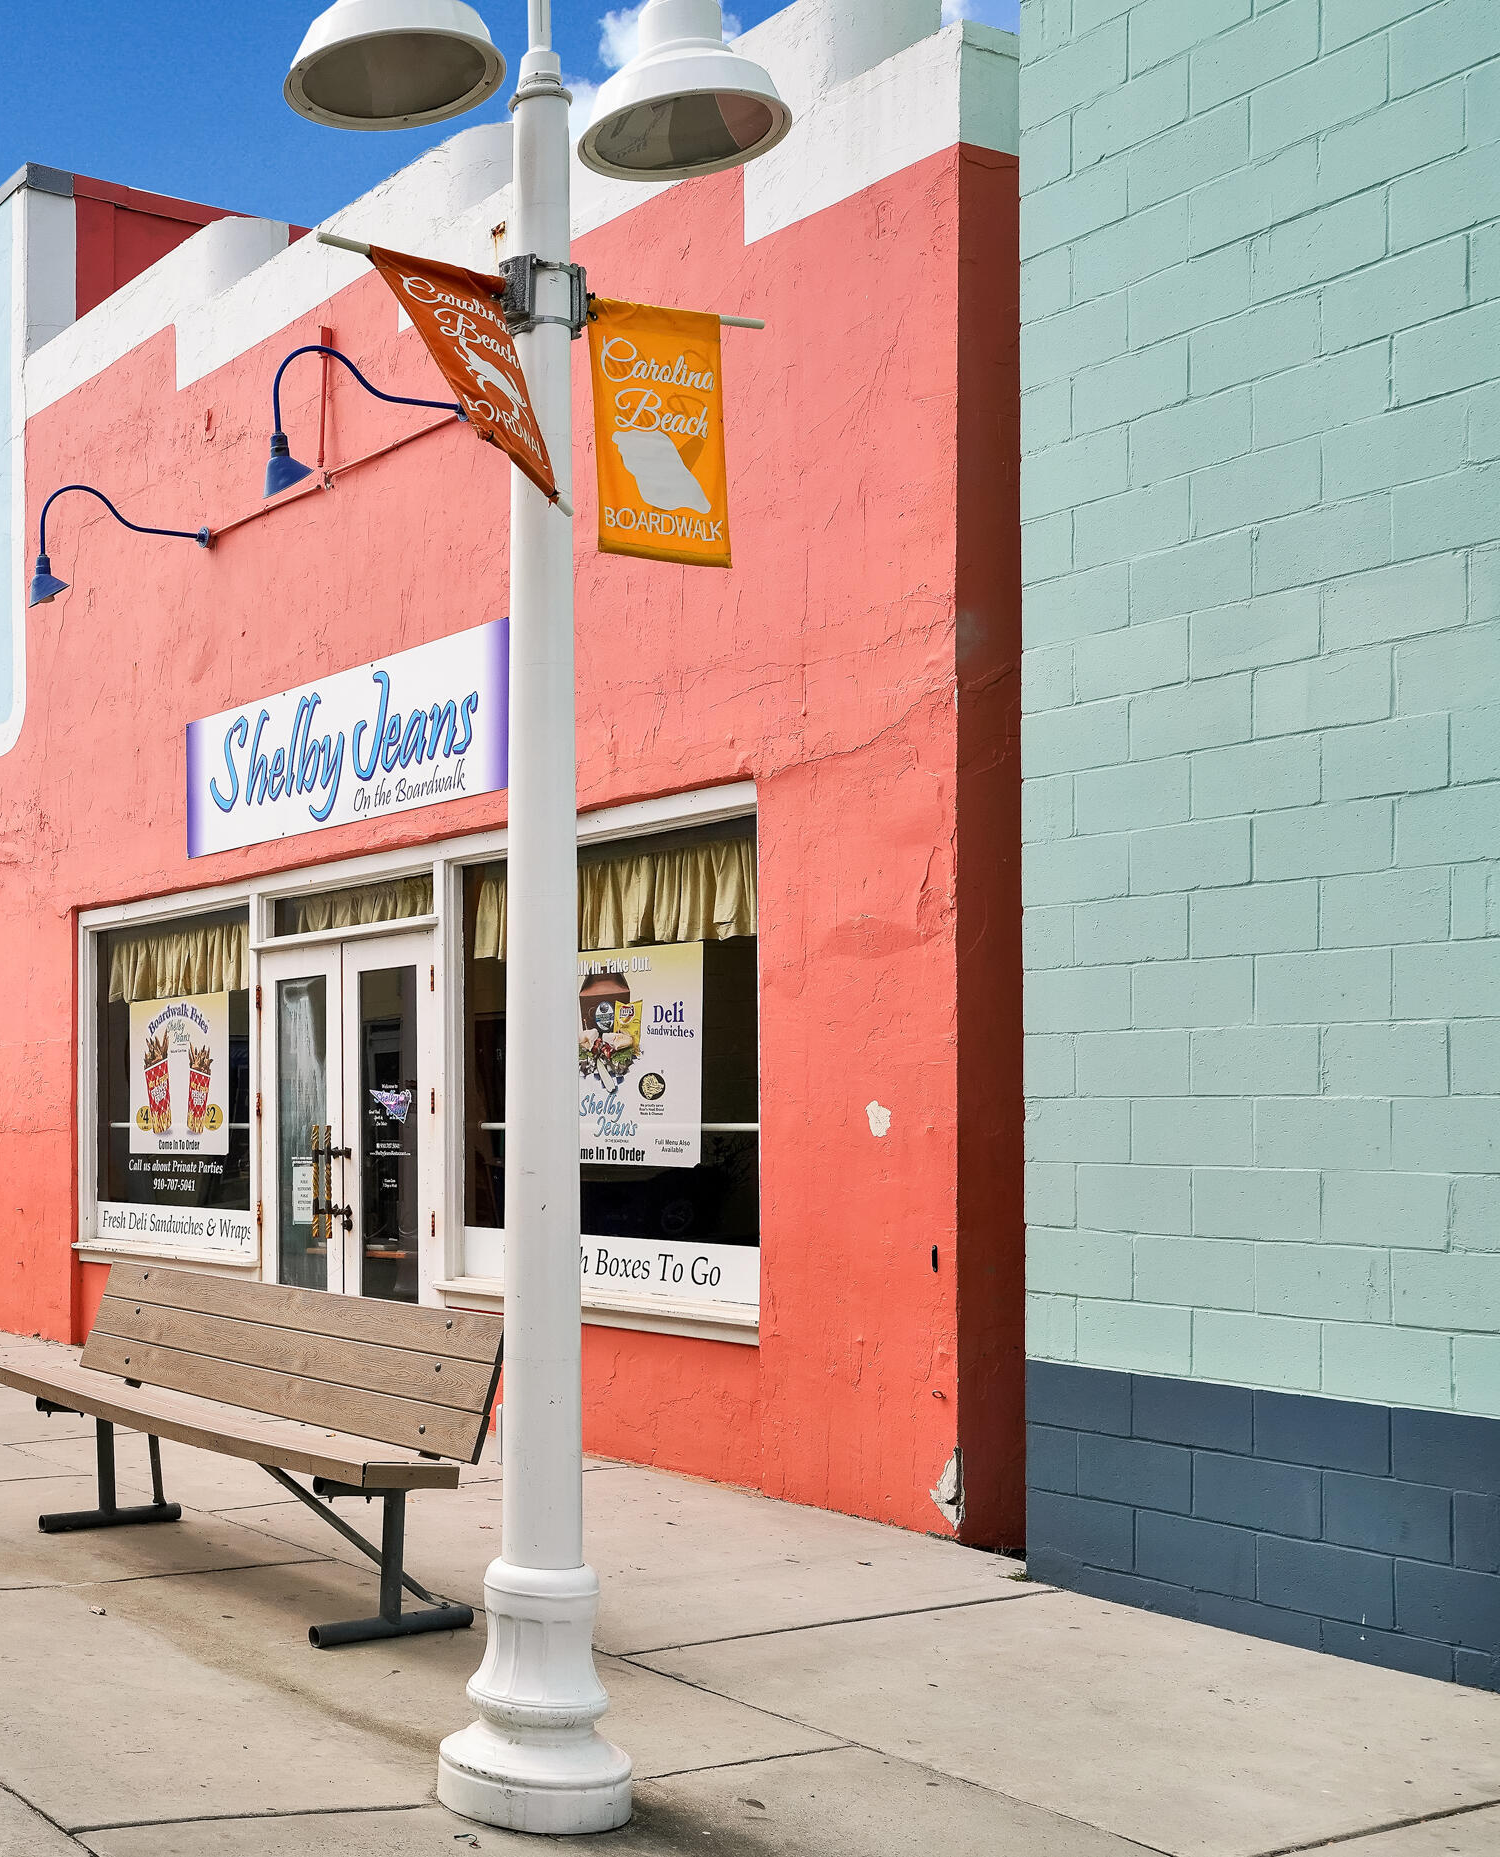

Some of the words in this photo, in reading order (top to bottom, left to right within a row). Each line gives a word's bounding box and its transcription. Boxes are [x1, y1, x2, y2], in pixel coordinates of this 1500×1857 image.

[398, 273, 509, 335] Carolina
[434, 307, 520, 370] Beach
[600, 336, 714, 391] Carolina
[614, 388, 708, 438] Beach
[462, 393, 549, 470] OARDWAL
[604, 506, 724, 542] BOARDWALK
[210, 692, 345, 822] Shelby
[352, 671, 478, 781] Jeans
[354, 788, 371, 812] On
[374, 784, 391, 807] the
[395, 758, 467, 803] Boardwalk
[578, 960, 590, 976] lk
[591, 960, 603, 974] In.
[605, 958, 629, 974] Take
[631, 956, 652, 972] Out.
[148, 1003, 189, 1036] Boardwalk
[190, 1007, 208, 1034] Fries
[653, 1001, 684, 1023] Deli
[646, 1025, 694, 1038] Sandwiches
[140, 1108, 149, 1124] $4
[207, 1107, 216, 1123] $2
[579, 1093, 625, 1123] Shelby
[594, 1116, 638, 1137] Jean's
[159, 1140, 172, 1149] Come
[173, 1140, 178, 1149] In
[179, 1140, 185, 1149] To
[186, 1140, 200, 1150] Order
[580, 1148, 593, 1160] me
[596, 1147, 604, 1160] In
[606, 1147, 617, 1160] To
[620, 1147, 645, 1161] Order
[129, 1159, 142, 1171] Call
[143, 1163, 151, 1171] us
[152, 1160, 171, 1172] about
[172, 1160, 197, 1173] Private
[198, 1161, 223, 1174] Parties
[153, 1179, 195, 1192] 910-707-5041
[102, 1210, 126, 1229] Fresh
[129, 1212, 147, 1231] Deli
[150, 1214, 203, 1235] Sandwiches
[207, 1218, 216, 1236] &
[219, 1218, 251, 1246] Wraps
[595, 1249, 650, 1280] Boxes
[658, 1254, 683, 1282] To
[691, 1257, 721, 1286] Go
